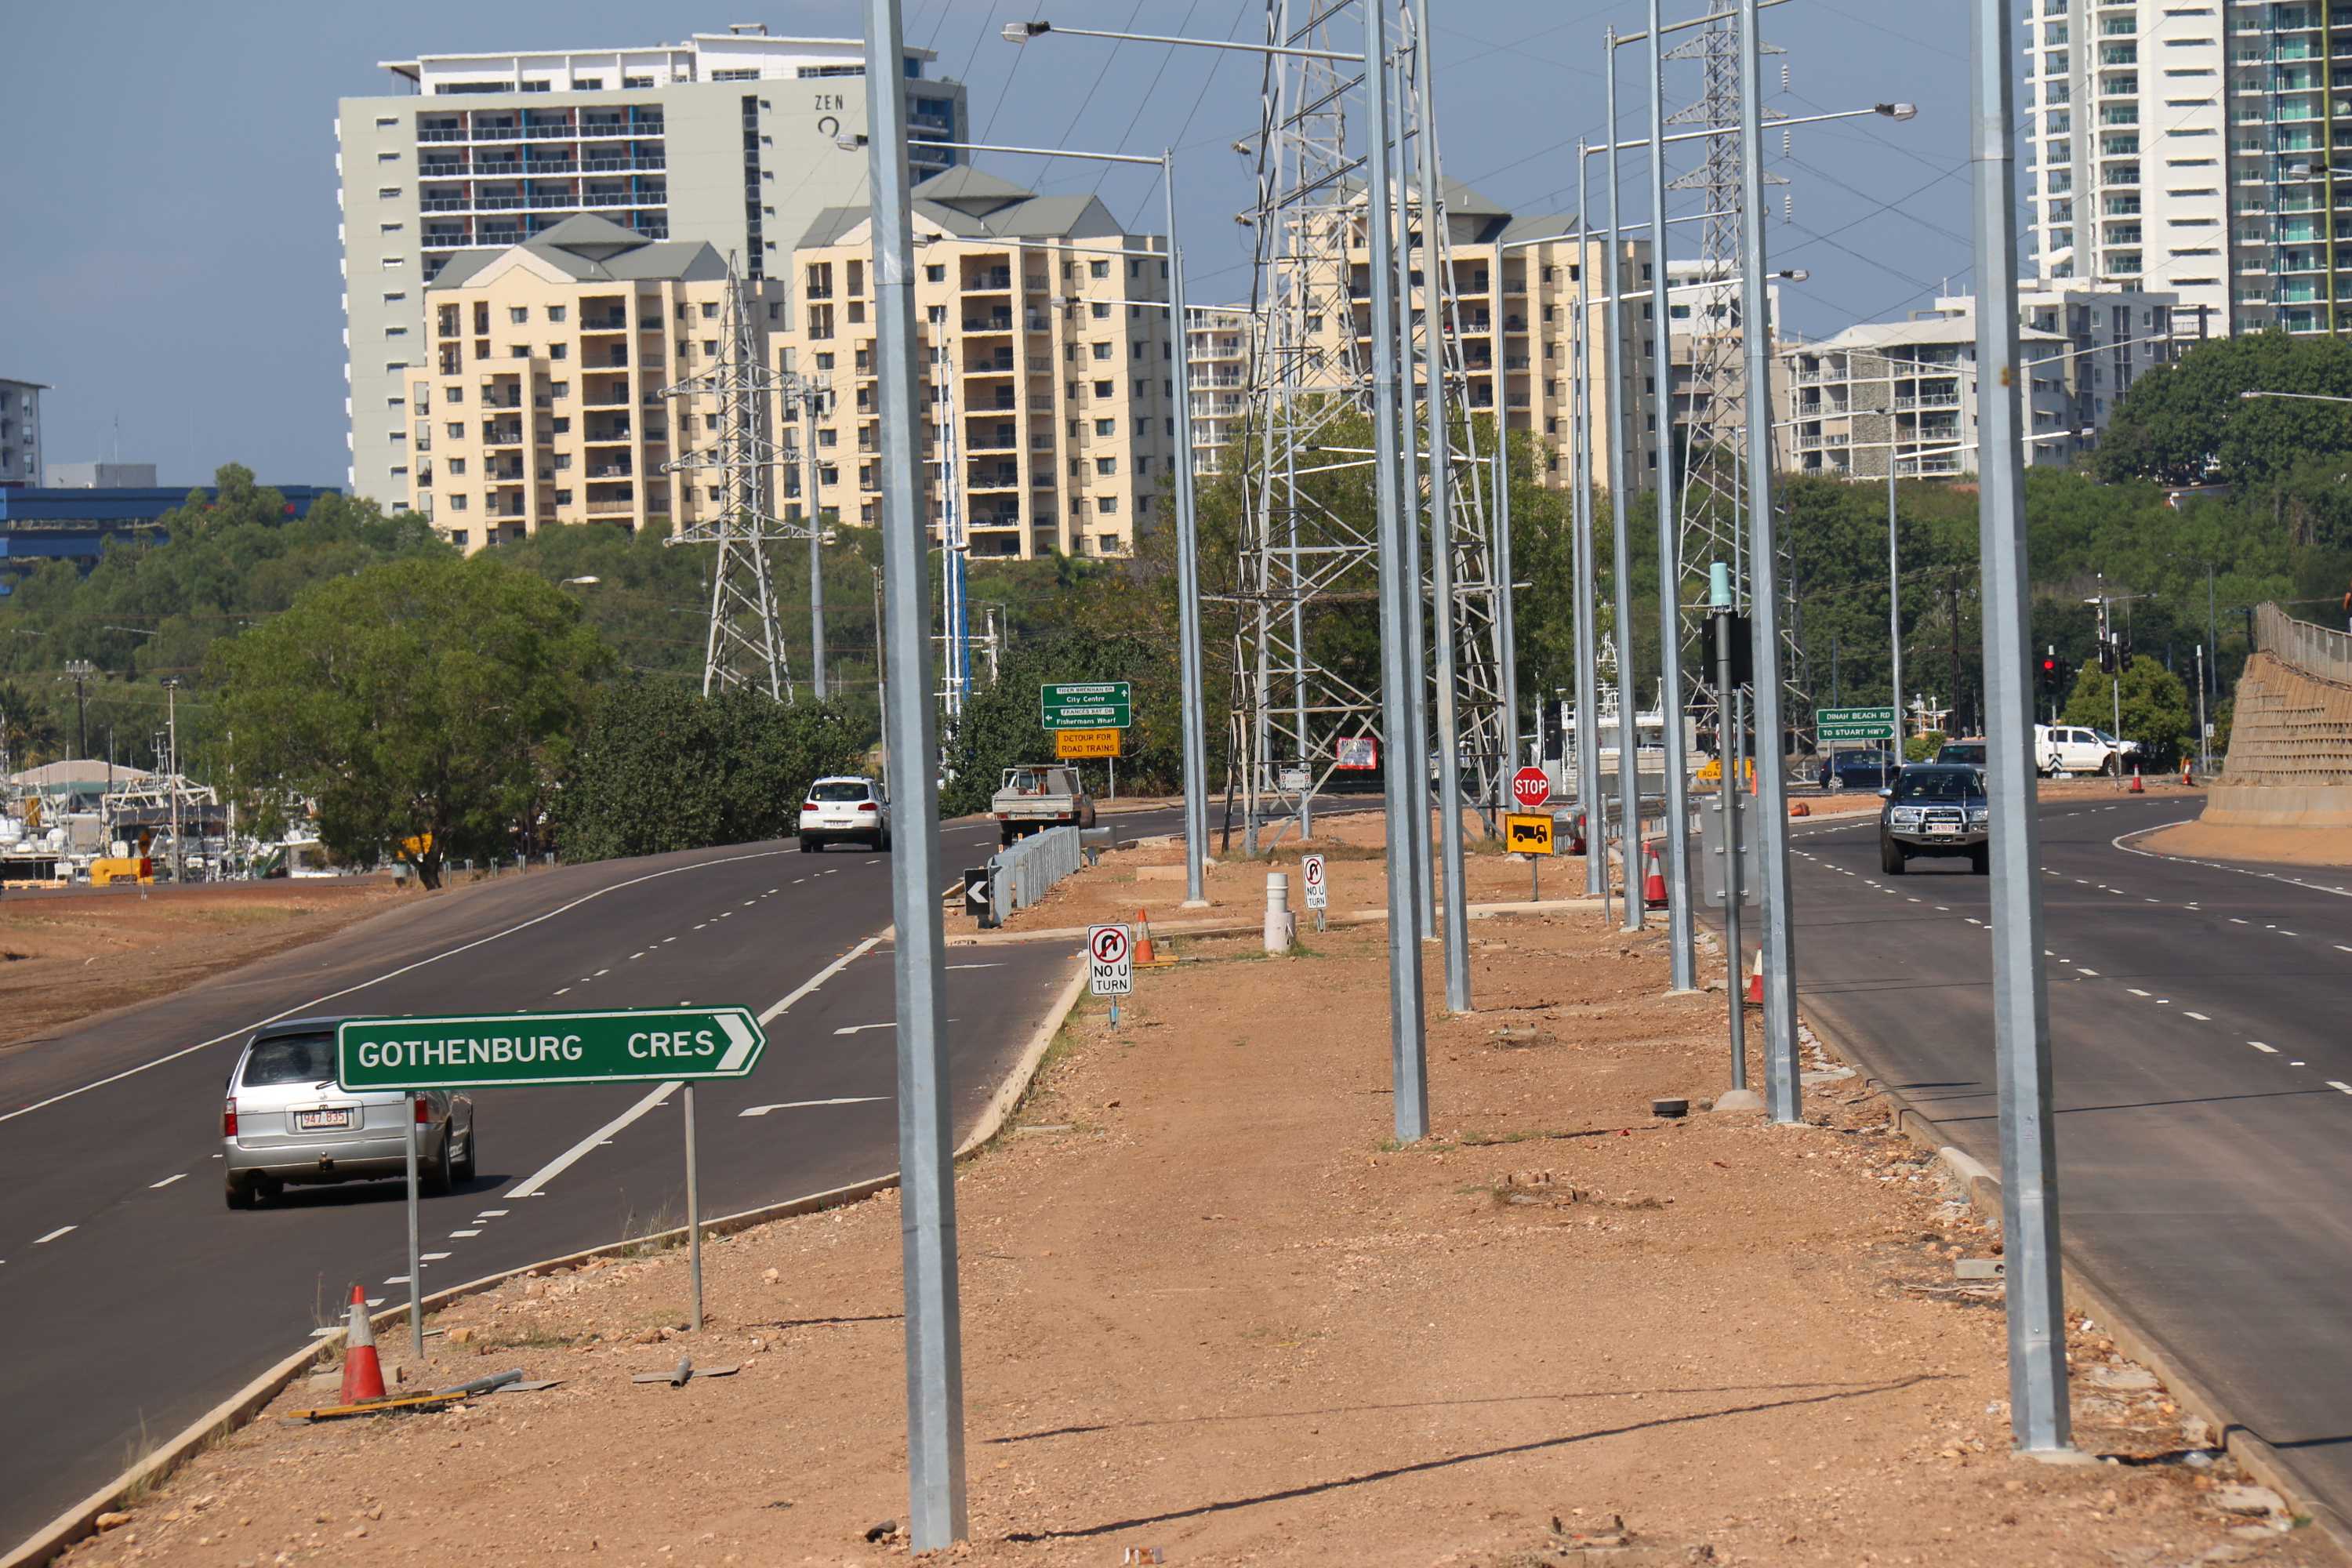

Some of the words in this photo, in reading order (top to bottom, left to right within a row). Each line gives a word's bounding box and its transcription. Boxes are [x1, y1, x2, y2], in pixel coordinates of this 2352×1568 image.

[815, 94, 844, 111] ZEN
[1063, 734, 1094, 742] DETOUR
[1087, 744, 1114, 753] TRAINS
[1515, 779, 1548, 795] STOP
[1307, 885, 1317, 895] NO
[1319, 885, 1324, 895] U
[1308, 897, 1325, 906] TURN
[1094, 964, 1113, 978] NO
[1118, 964, 1127, 977] U
[1096, 978, 1127, 991] TURN
[358, 1034, 583, 1068] GOTHENBURG
[627, 1029, 716, 1059] CRES
